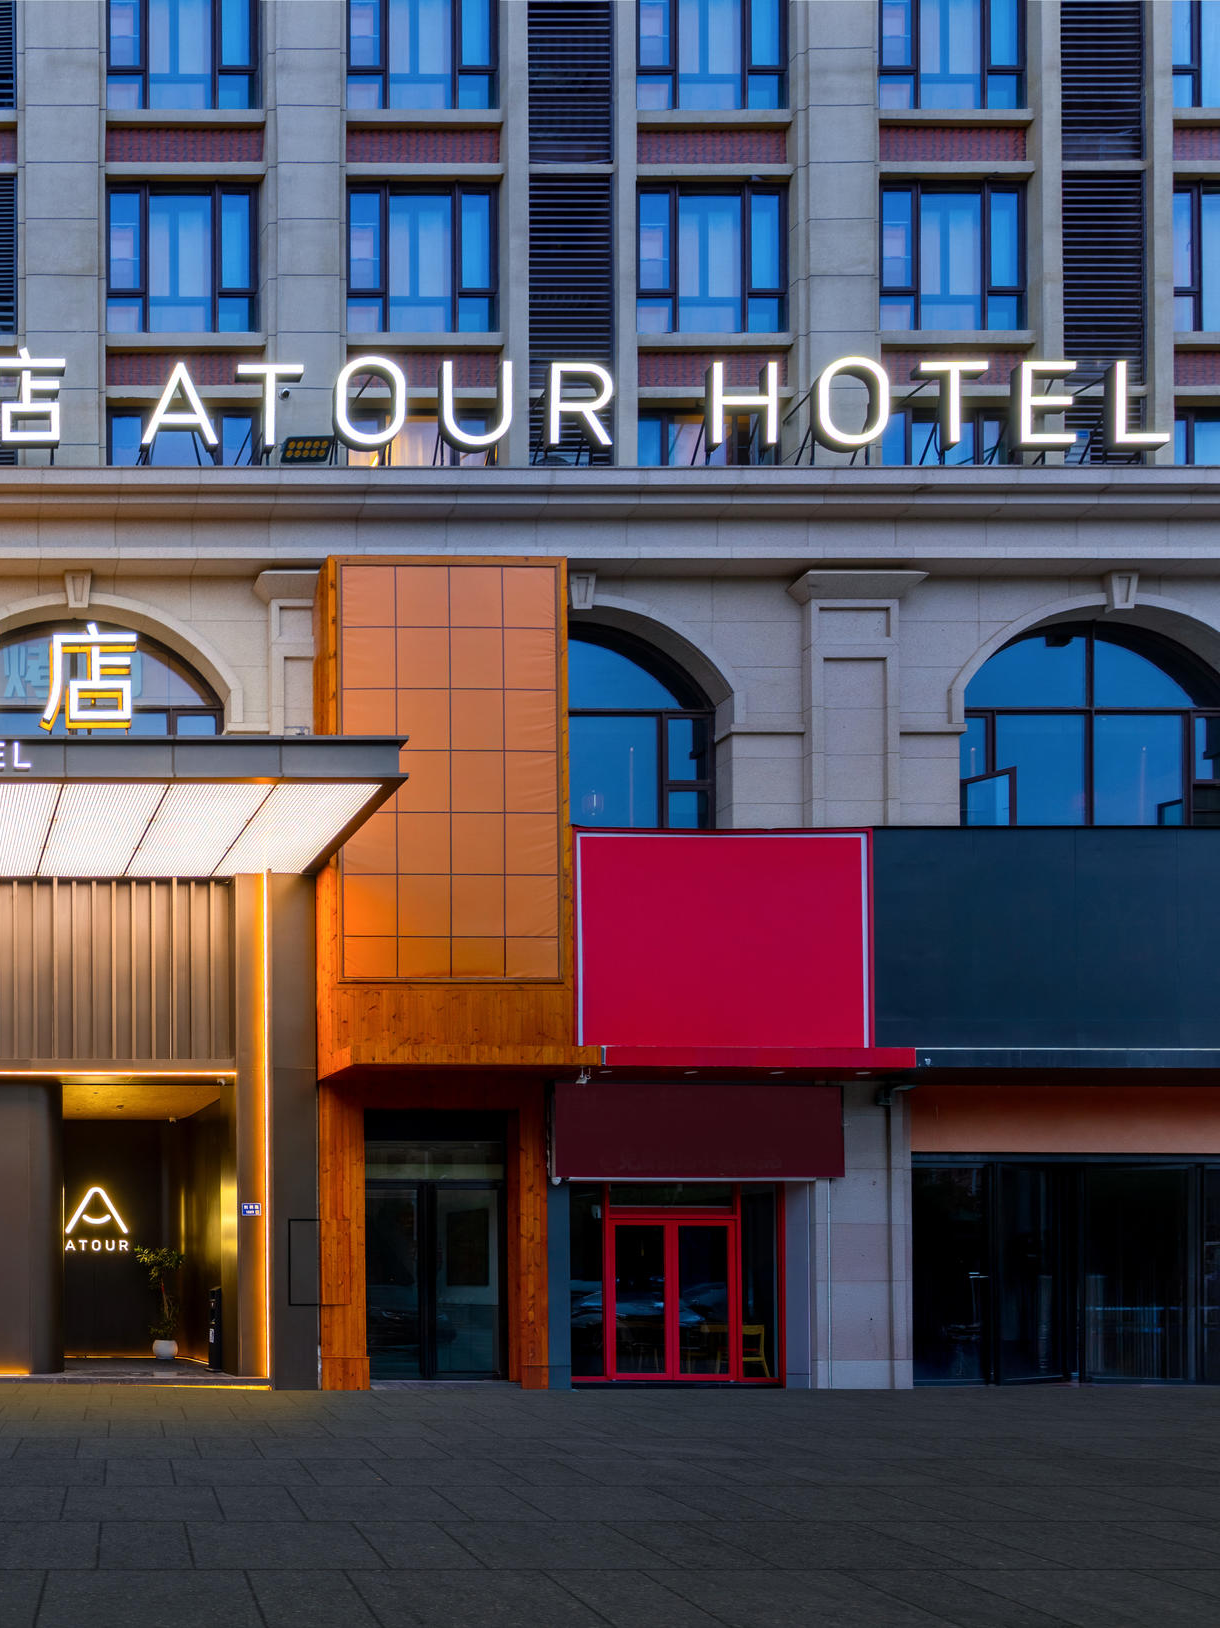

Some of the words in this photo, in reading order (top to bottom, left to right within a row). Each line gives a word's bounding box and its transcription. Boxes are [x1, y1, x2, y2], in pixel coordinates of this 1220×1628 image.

[140, 355, 614, 449] ATOUR
[706, 355, 1171, 451] HOTEL
[65, 1239, 129, 1251] ATOUR
